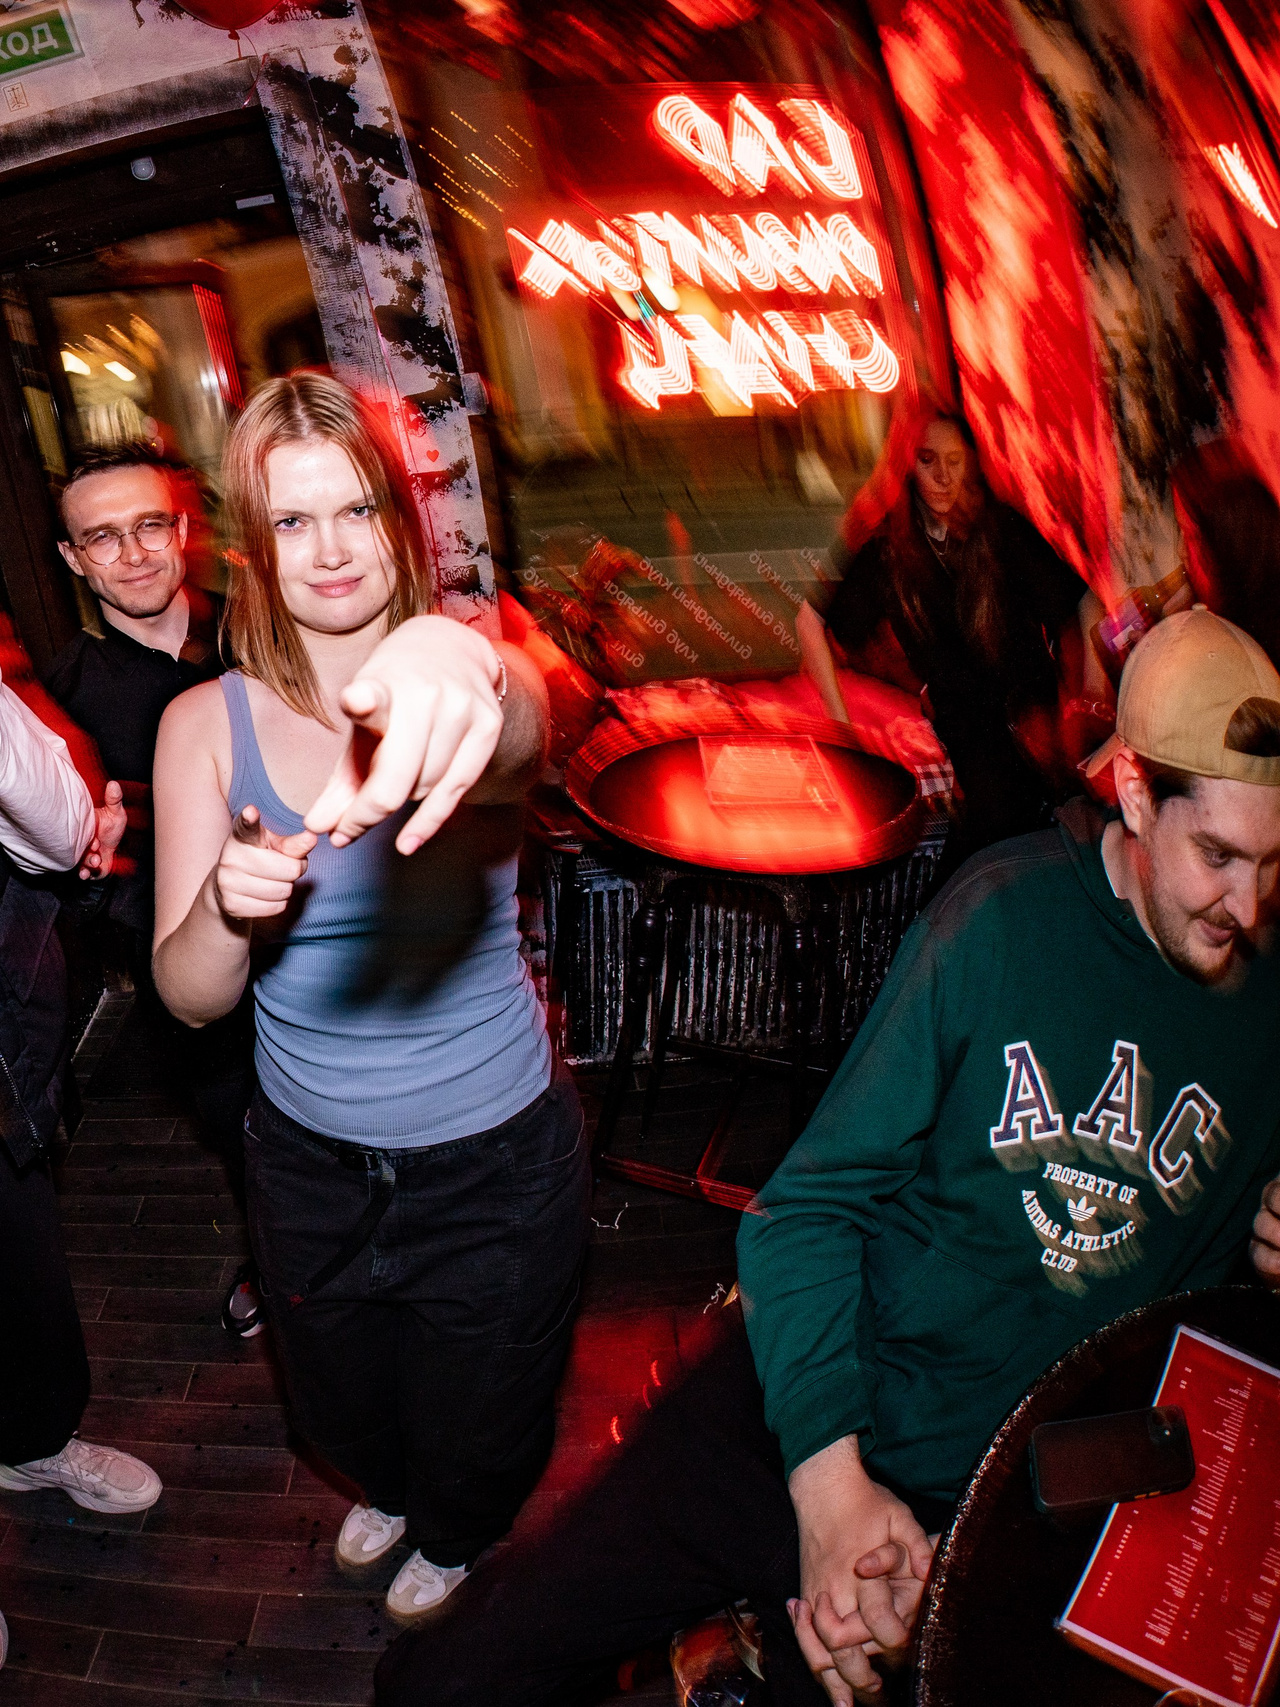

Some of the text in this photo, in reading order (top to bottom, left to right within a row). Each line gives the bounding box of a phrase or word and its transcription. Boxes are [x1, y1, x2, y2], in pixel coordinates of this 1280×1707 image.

[1042, 1162, 1139, 1205] PROPERTY OF
[1021, 1189, 1136, 1252] ADIDAS ATHLETIC
[1040, 1247, 1078, 1273] CLUB
